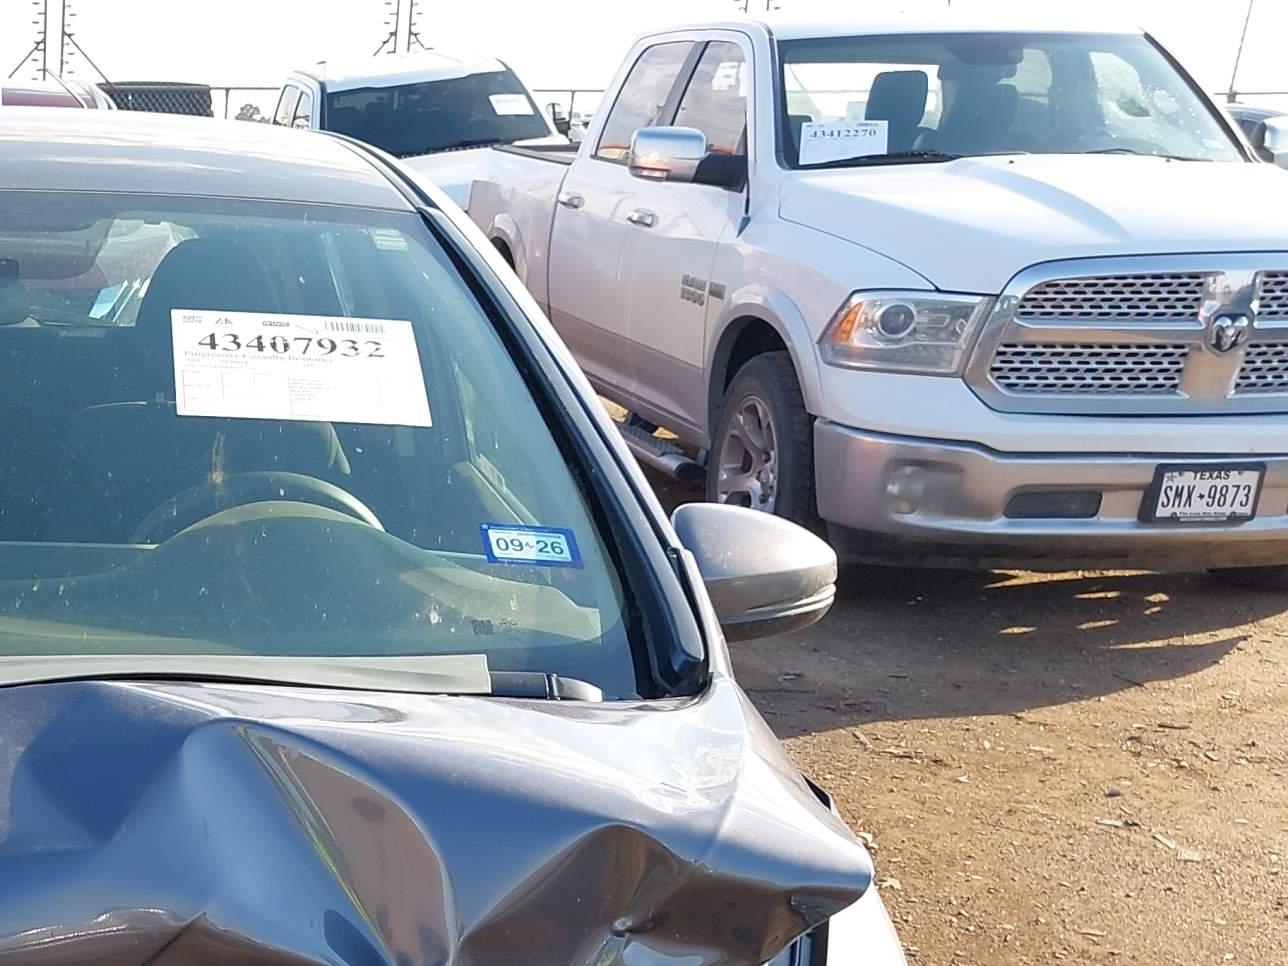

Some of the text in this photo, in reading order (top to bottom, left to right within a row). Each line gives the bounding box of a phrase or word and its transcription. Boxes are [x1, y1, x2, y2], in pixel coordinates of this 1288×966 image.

[809, 129, 877, 139] 43412270
[197, 332, 386, 358] 43407932
[1193, 471, 1231, 481] TEXAS
[1161, 484, 1252, 508] SMX 9873
